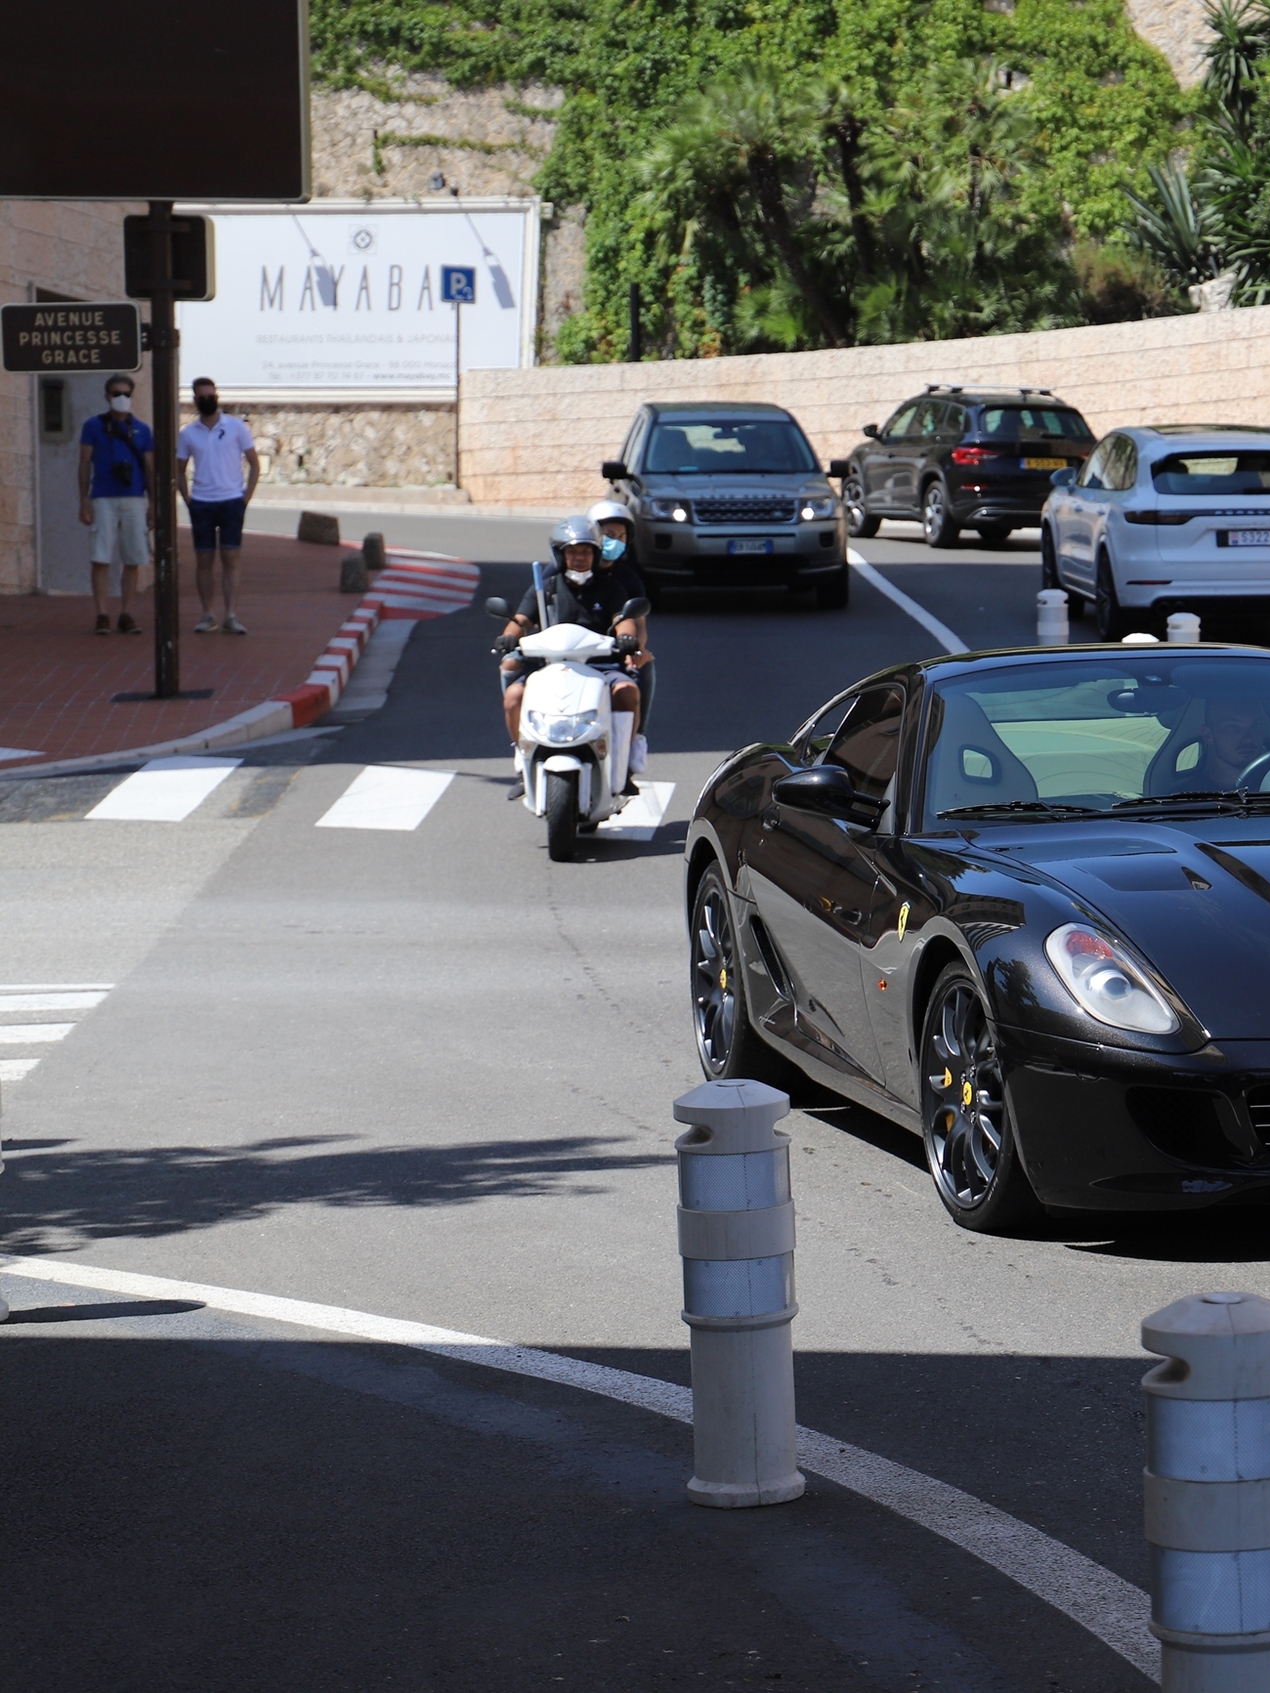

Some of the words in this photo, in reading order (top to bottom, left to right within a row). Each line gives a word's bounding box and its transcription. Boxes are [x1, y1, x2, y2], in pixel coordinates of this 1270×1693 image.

[259, 264, 458, 312] MAYABA
[451, 271, 468, 296] P
[34, 311, 104, 327] AVENUE
[19, 330, 121, 346] PRINCESSE
[41, 349, 101, 364] GRACE
